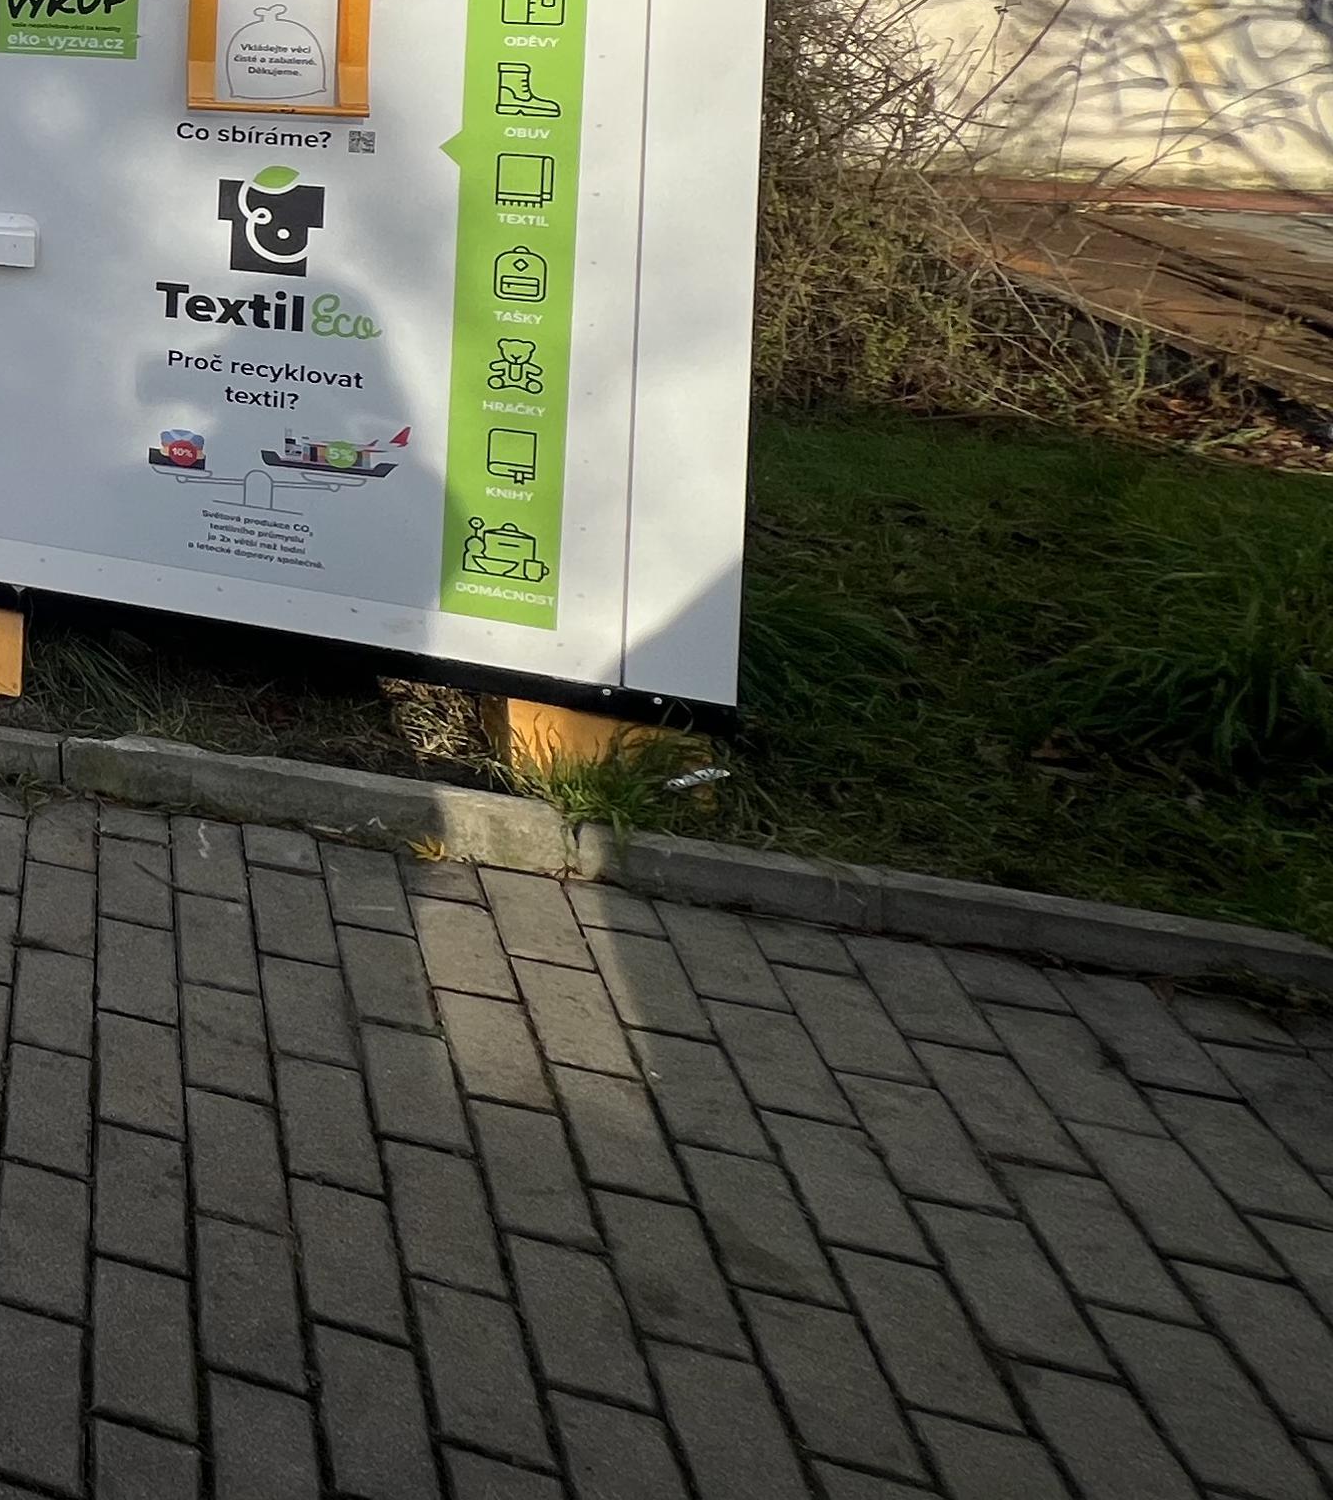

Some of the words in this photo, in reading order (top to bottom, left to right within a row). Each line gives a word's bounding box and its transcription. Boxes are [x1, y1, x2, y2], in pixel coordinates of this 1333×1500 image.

[7, 31, 125, 50] eko-vyzva.cz
[240, 43, 288, 54] Vkládejte
[290, 45, 311, 53] věci
[234, 55, 257, 64] čisté
[248, 66, 302, 76] Děkujeme.
[176, 122, 209, 141] Co
[218, 125, 332, 149] sbíráme?
[504, 127, 551, 140] OBUV
[497, 213, 549, 227] TEXTIL
[156, 281, 305, 332] Textil
[311, 293, 382, 340] Eco
[493, 309, 543, 325] TAŠKY
[168, 350, 223, 373] Proč
[230, 360, 364, 389] recyklovat
[225, 386, 299, 410] textil?
[483, 400, 546, 417] HRAČKY
[171, 447, 194, 459] 10%
[332, 448, 356, 461] 5%
[485, 486, 534, 501] KNIHY
[455, 580, 556, 607] DOMÁCNOST
